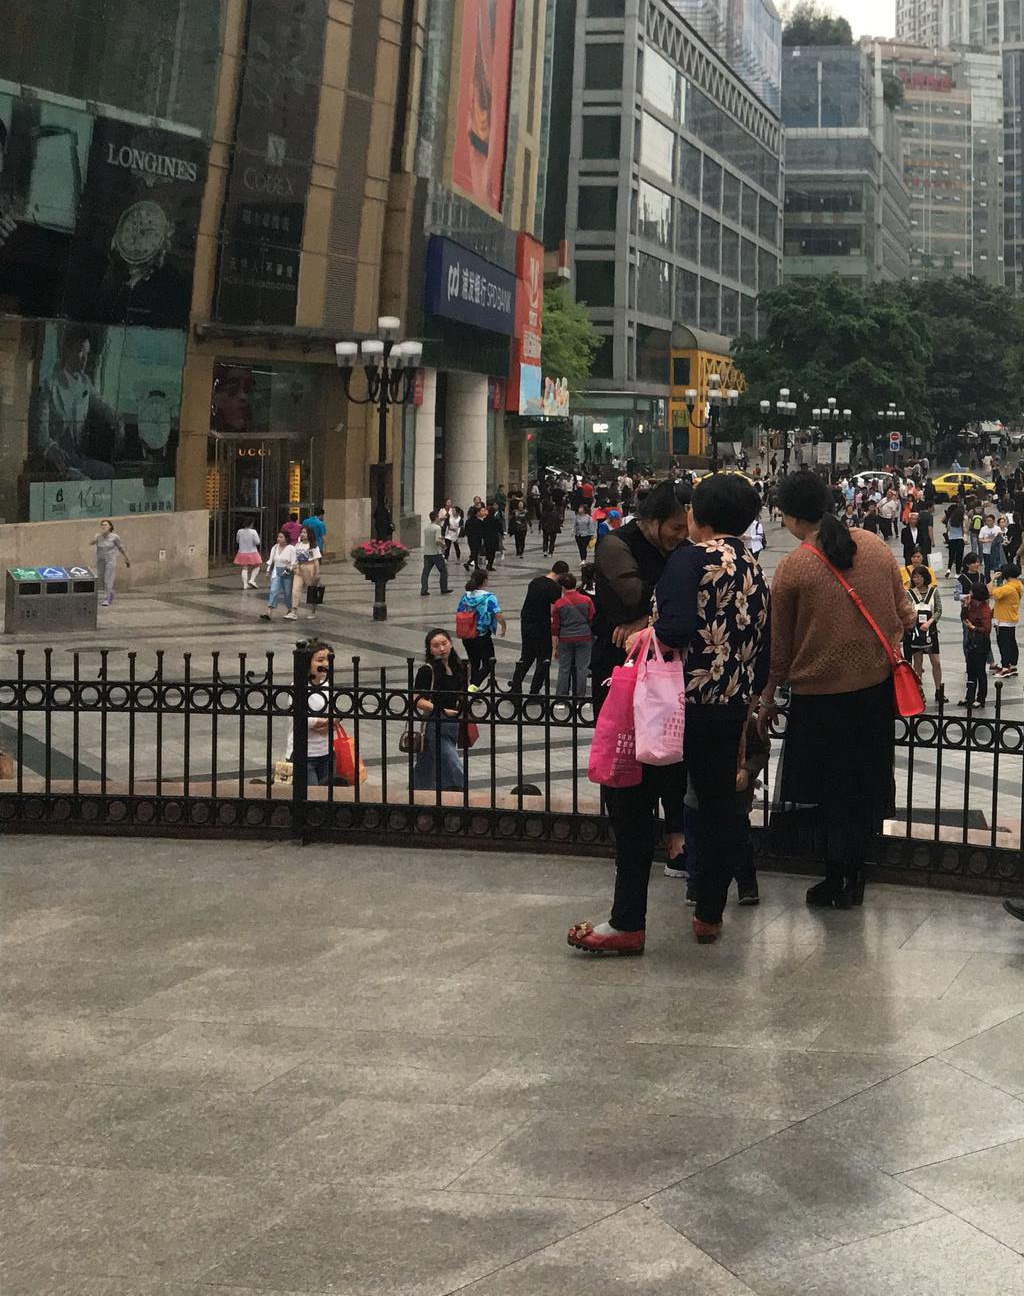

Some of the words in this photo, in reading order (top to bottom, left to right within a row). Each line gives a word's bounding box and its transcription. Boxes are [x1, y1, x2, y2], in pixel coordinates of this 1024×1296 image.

[106, 143, 199, 183] LONGINES
[462, 267, 487, 307] 浦发银行
